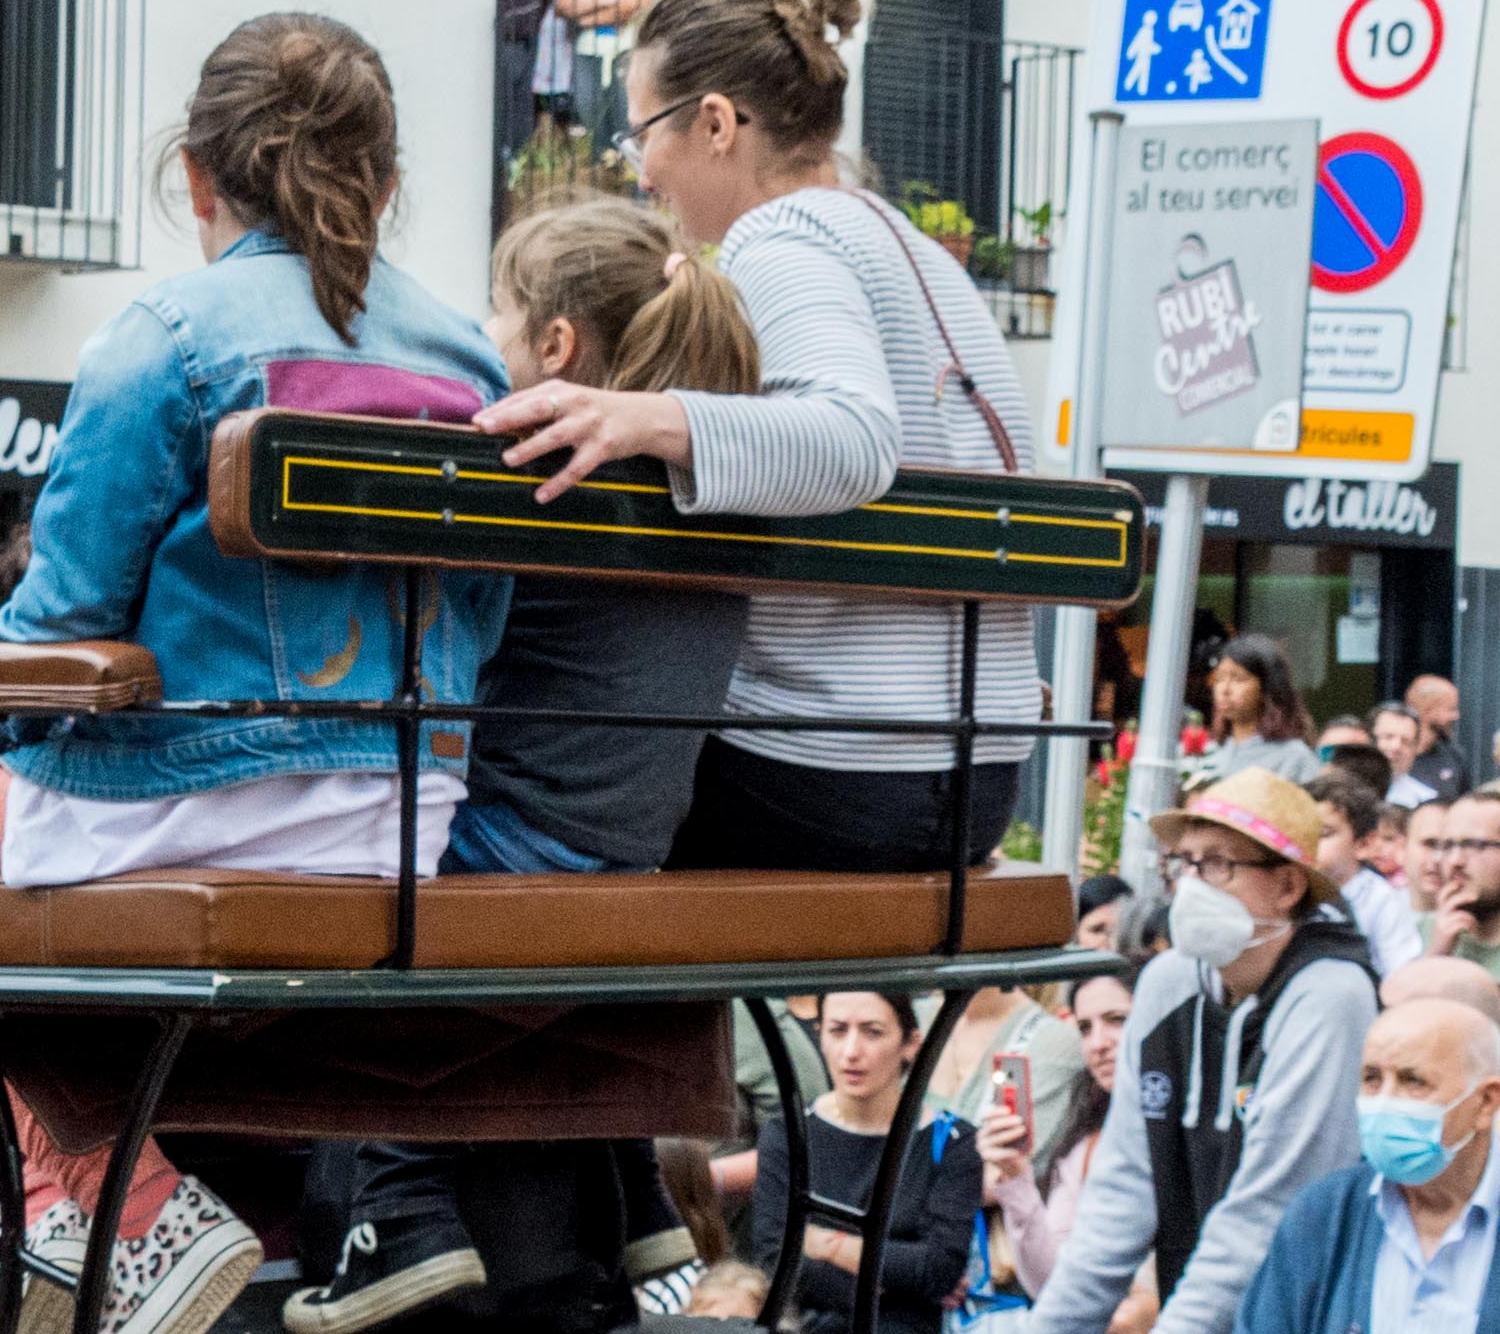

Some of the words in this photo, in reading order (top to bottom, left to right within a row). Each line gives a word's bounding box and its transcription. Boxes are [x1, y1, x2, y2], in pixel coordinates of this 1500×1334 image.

[1367, 20, 1415, 59] 10
[1140, 139, 1167, 172] El
[1175, 143, 1291, 174] comerç
[1126, 181, 1149, 212] al
[1159, 187, 1204, 213] teu
[1213, 176, 1300, 211] servei
[1283, 476, 1326, 530] el
[1326, 478, 1438, 537] taller
